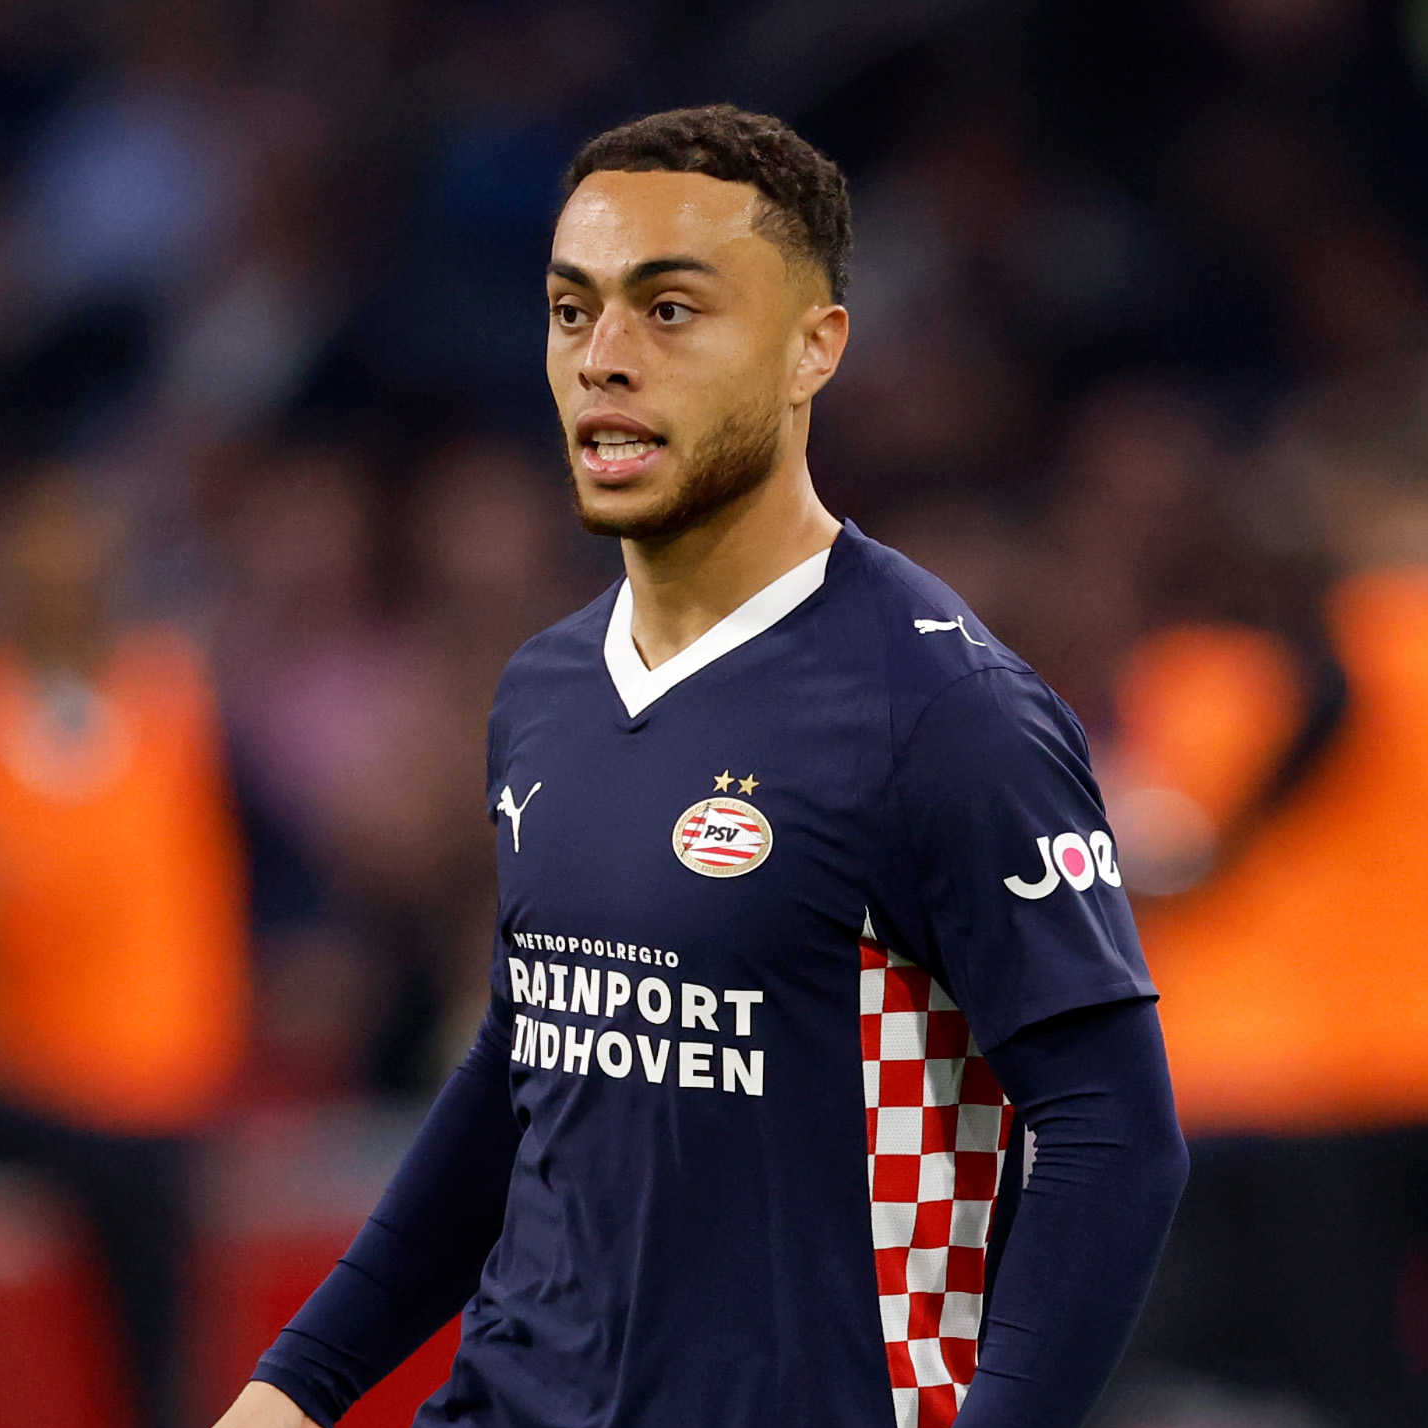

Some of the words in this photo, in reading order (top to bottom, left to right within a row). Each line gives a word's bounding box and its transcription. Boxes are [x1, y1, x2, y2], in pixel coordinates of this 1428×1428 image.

[704, 825, 740, 843] PSV
[513, 932, 679, 968] METROPOOLREGIO
[508, 957, 764, 1036] RAINPORT
[510, 1013, 764, 1096] INDHOVEN
